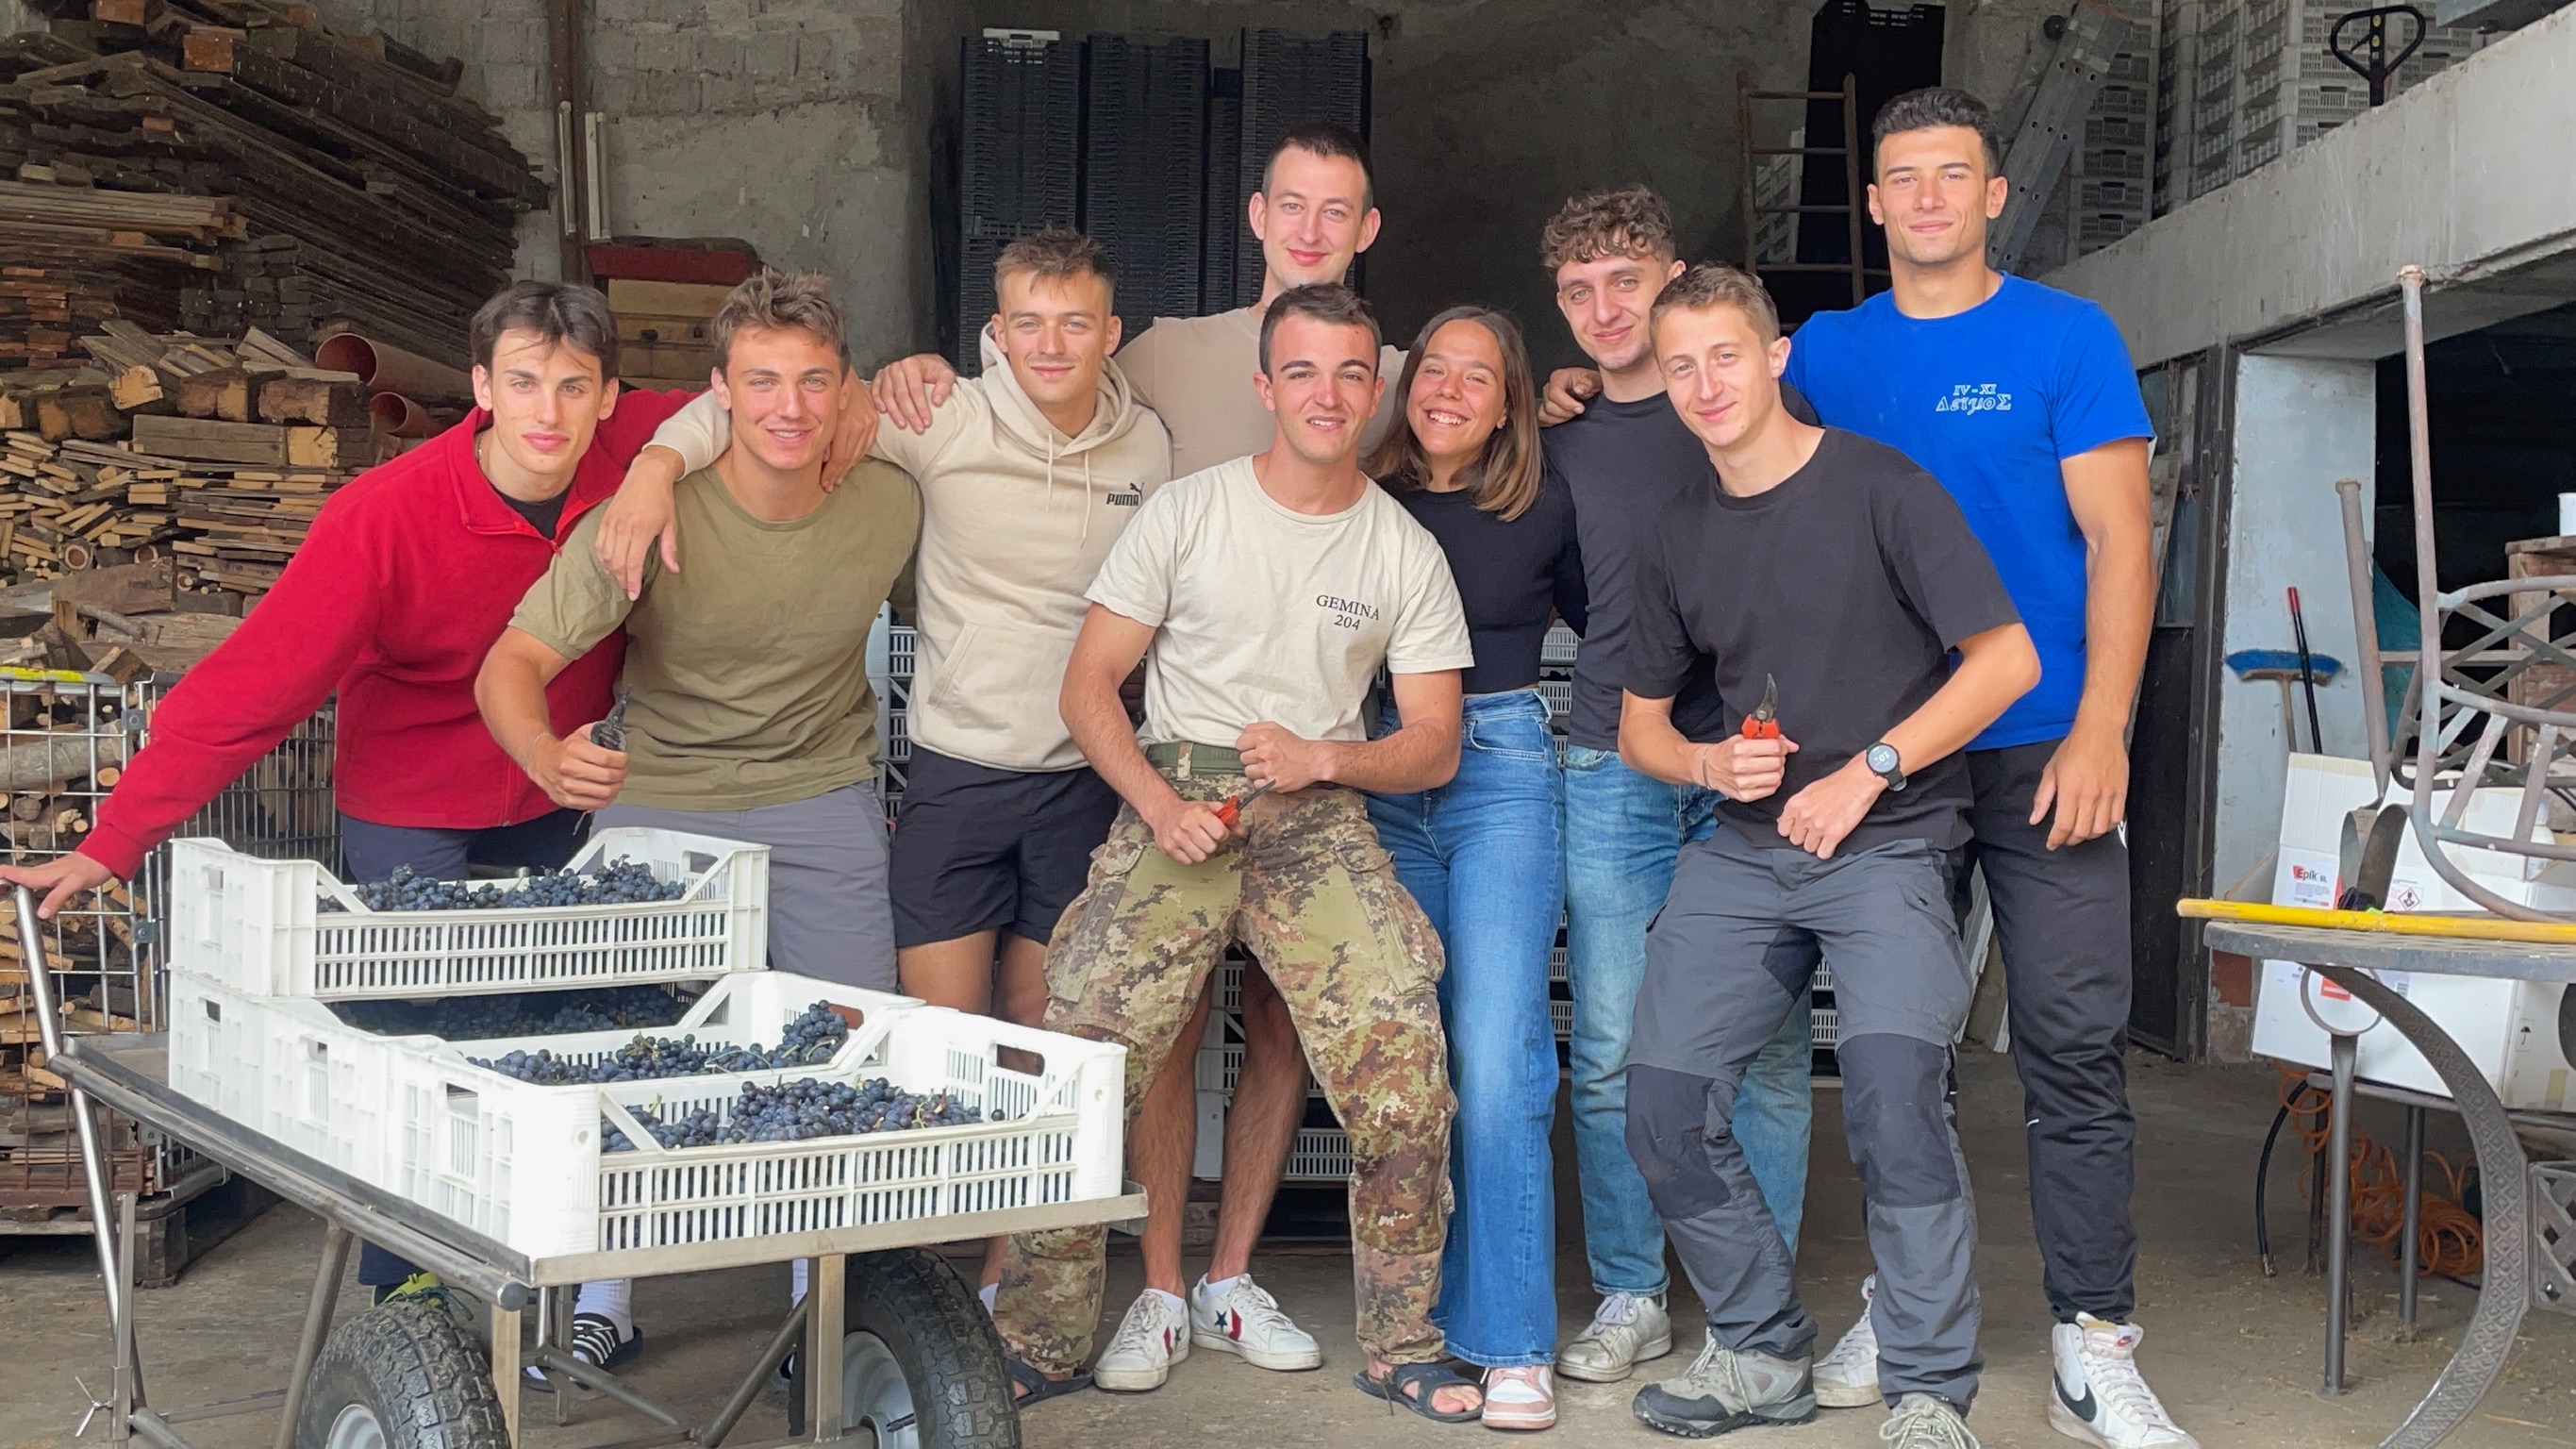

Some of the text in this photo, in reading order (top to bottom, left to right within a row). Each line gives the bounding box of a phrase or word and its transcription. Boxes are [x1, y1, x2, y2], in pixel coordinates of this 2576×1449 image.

[1106, 492, 1139, 507] PUMA
[1316, 594, 1379, 621] GEMINA
[1334, 614, 1361, 631] 204
